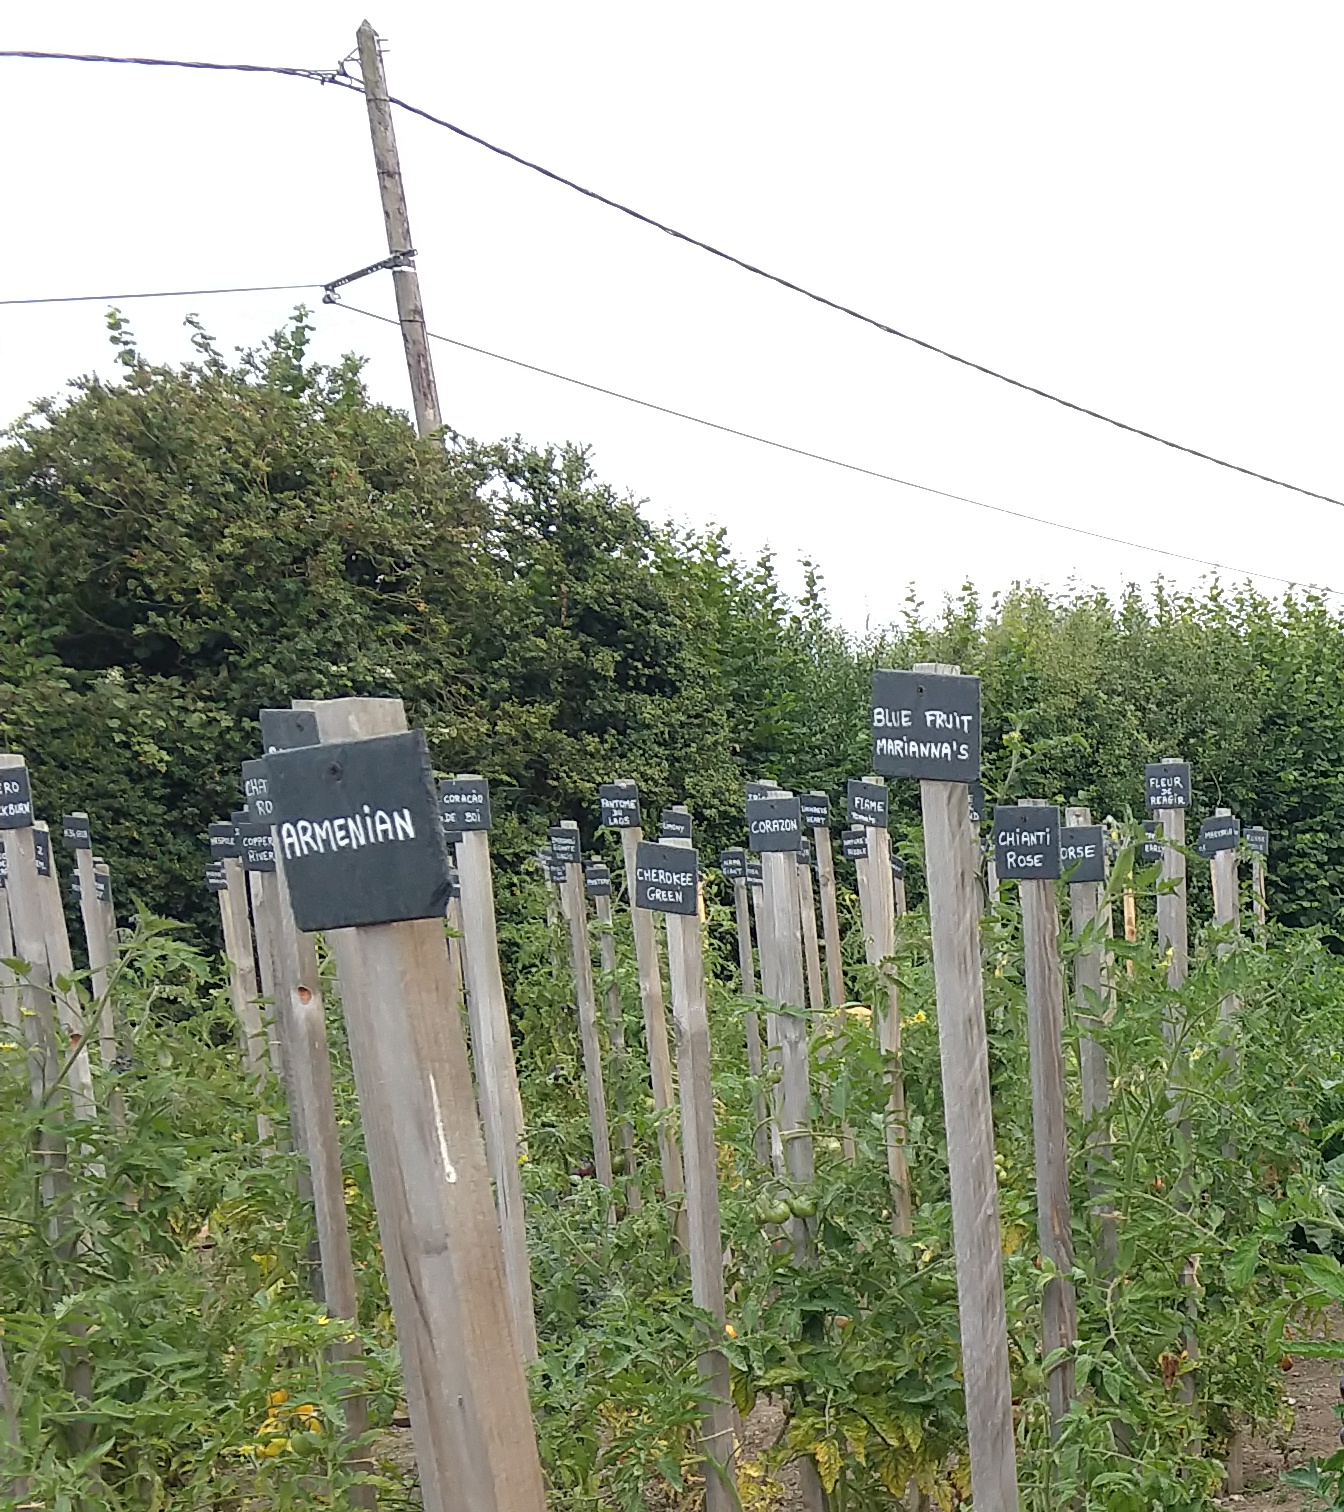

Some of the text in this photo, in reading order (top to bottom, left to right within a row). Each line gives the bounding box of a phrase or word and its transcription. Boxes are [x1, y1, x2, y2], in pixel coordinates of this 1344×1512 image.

[872, 707, 912, 727] BLUE
[1149, 776, 1184, 789] FLEUR
[750, 818, 798, 834] CORAZON
[636, 868, 694, 886] CHEROKEE
[646, 886, 683, 903] GREEN
